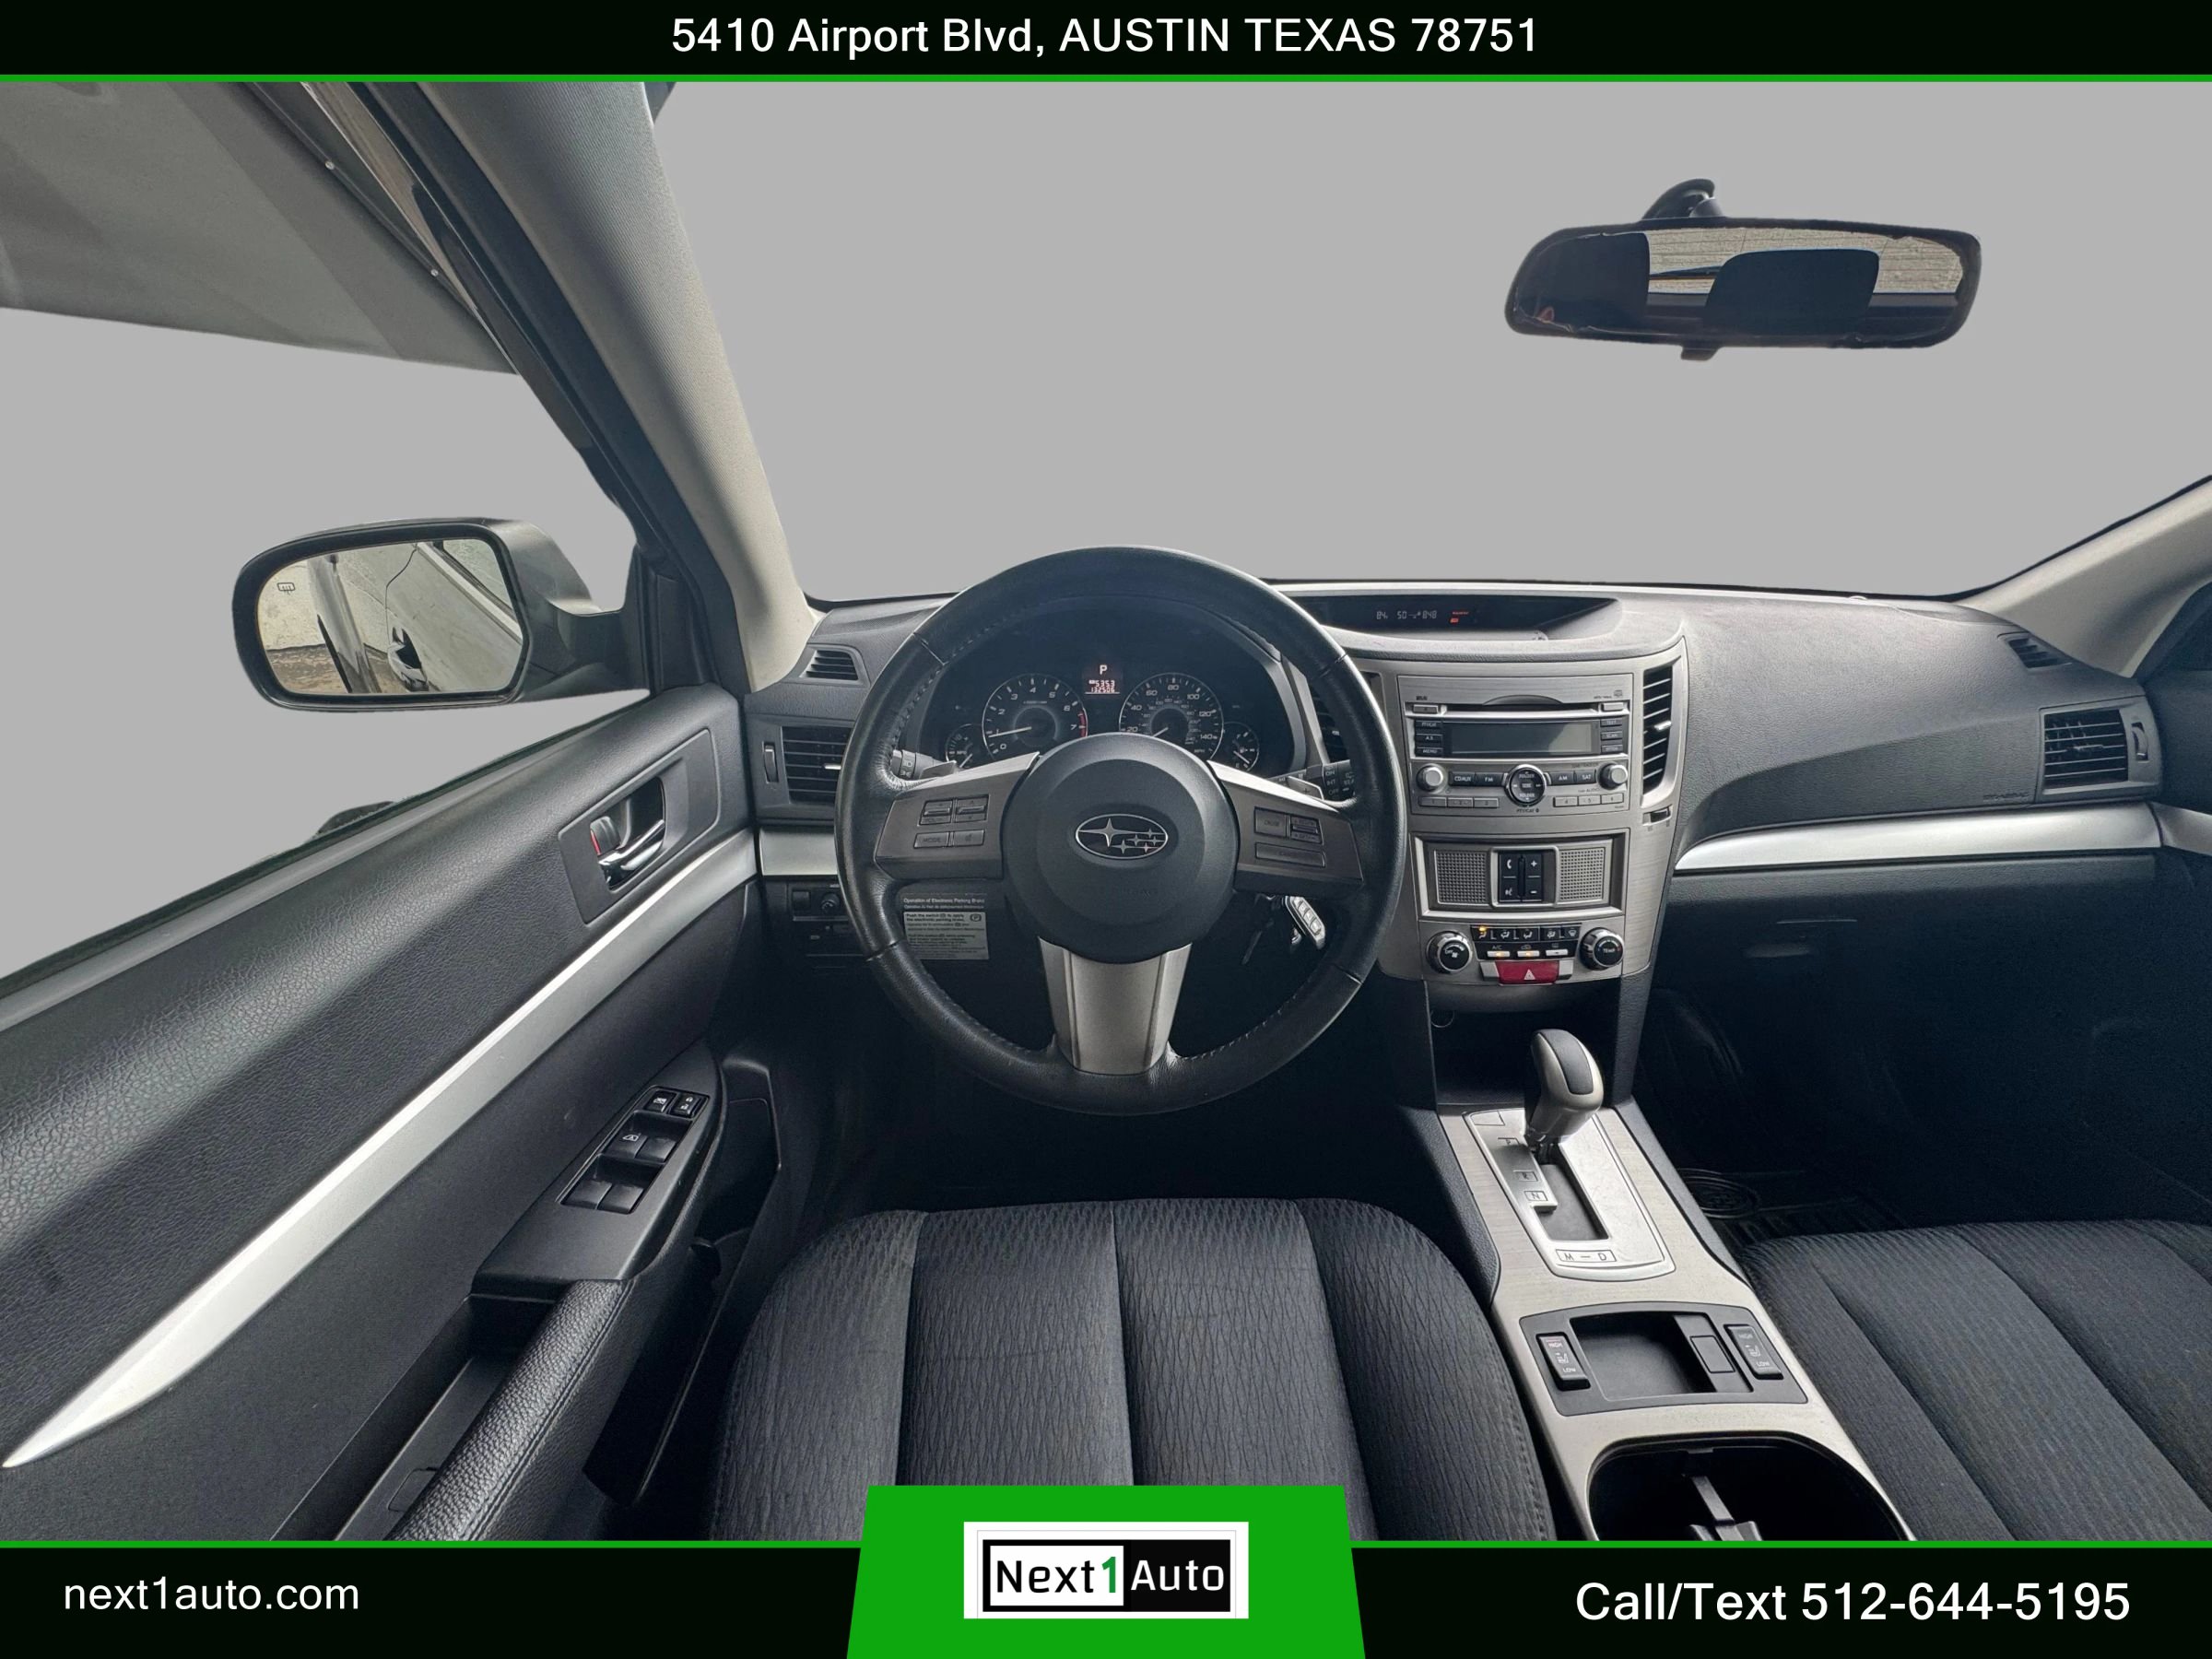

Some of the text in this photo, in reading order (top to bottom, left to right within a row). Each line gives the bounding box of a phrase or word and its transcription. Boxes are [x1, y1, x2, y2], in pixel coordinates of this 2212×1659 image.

[1100, 665, 1107, 675] P
[1563, 1252, 1607, 1262] M D
